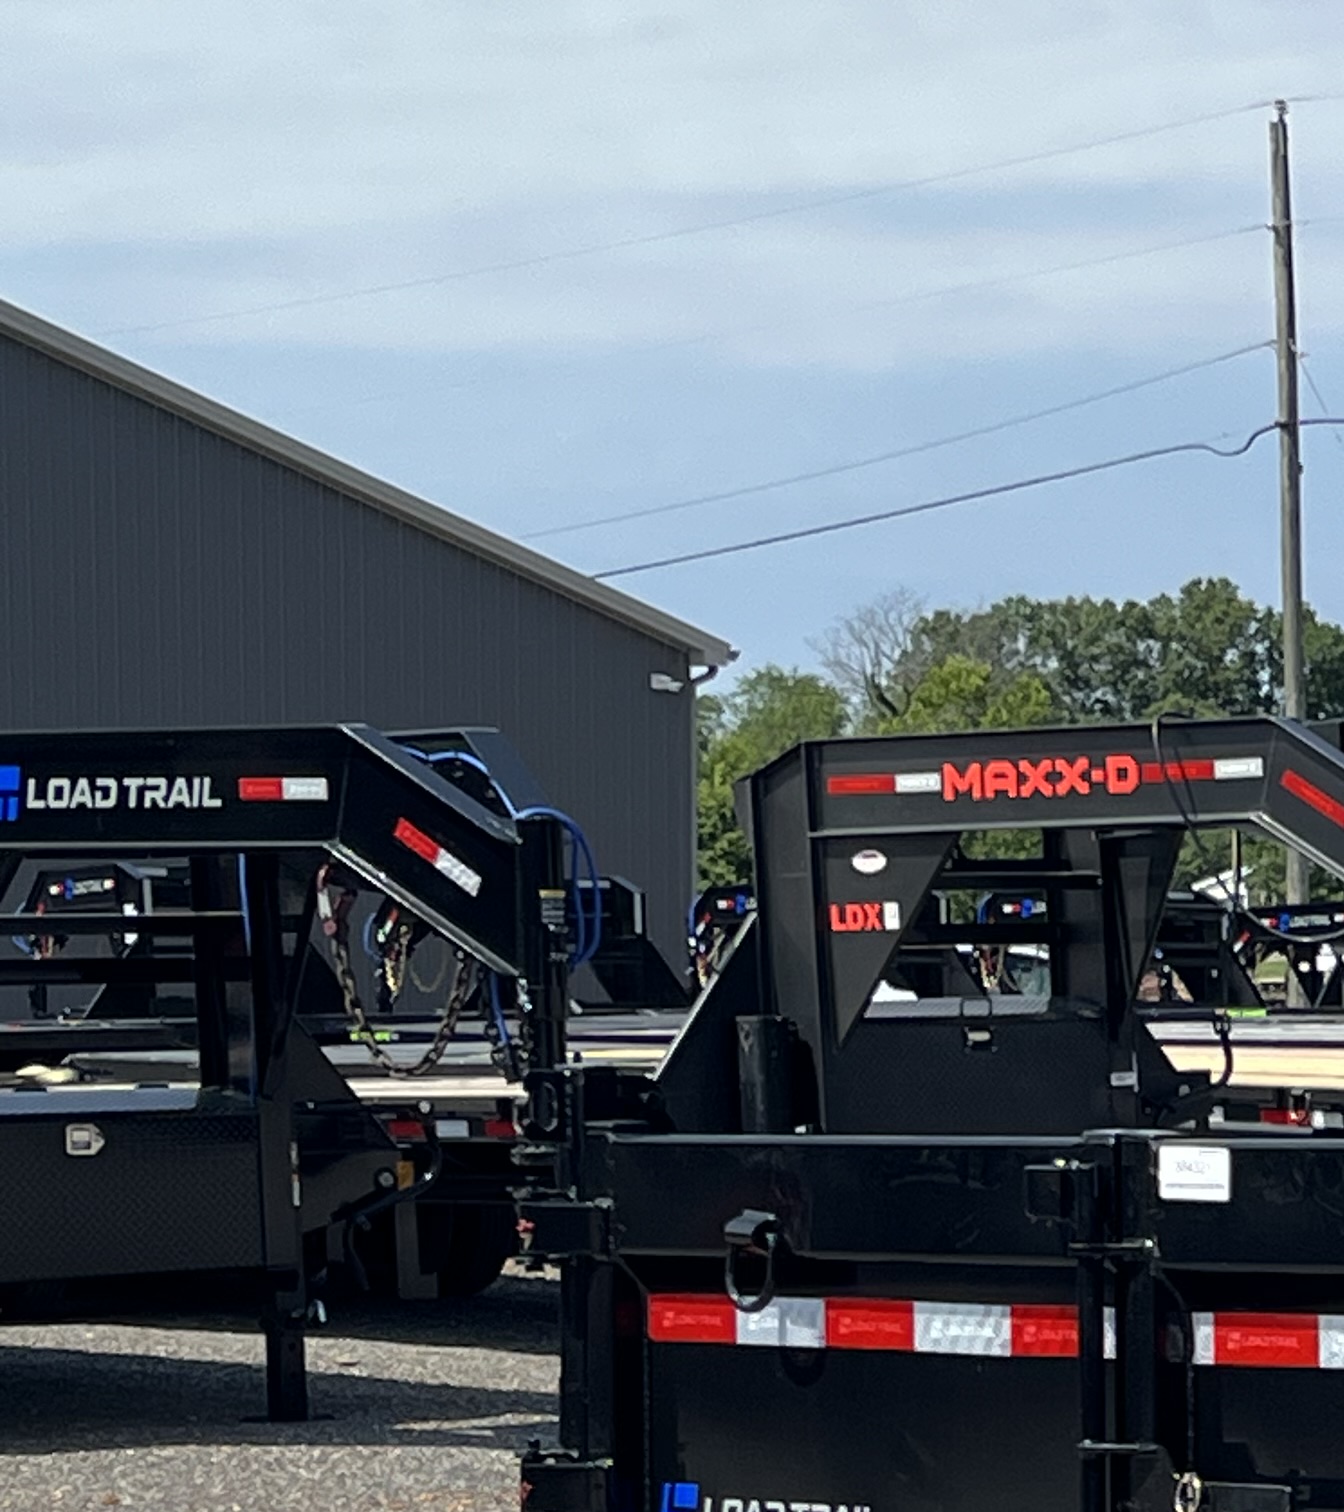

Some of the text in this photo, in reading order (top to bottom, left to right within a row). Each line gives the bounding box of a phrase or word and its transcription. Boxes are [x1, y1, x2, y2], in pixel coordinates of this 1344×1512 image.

[26, 776, 223, 809] LOAD TRAIL
[942, 754, 1140, 802] MAXX-D
[829, 901, 883, 932] LDX
